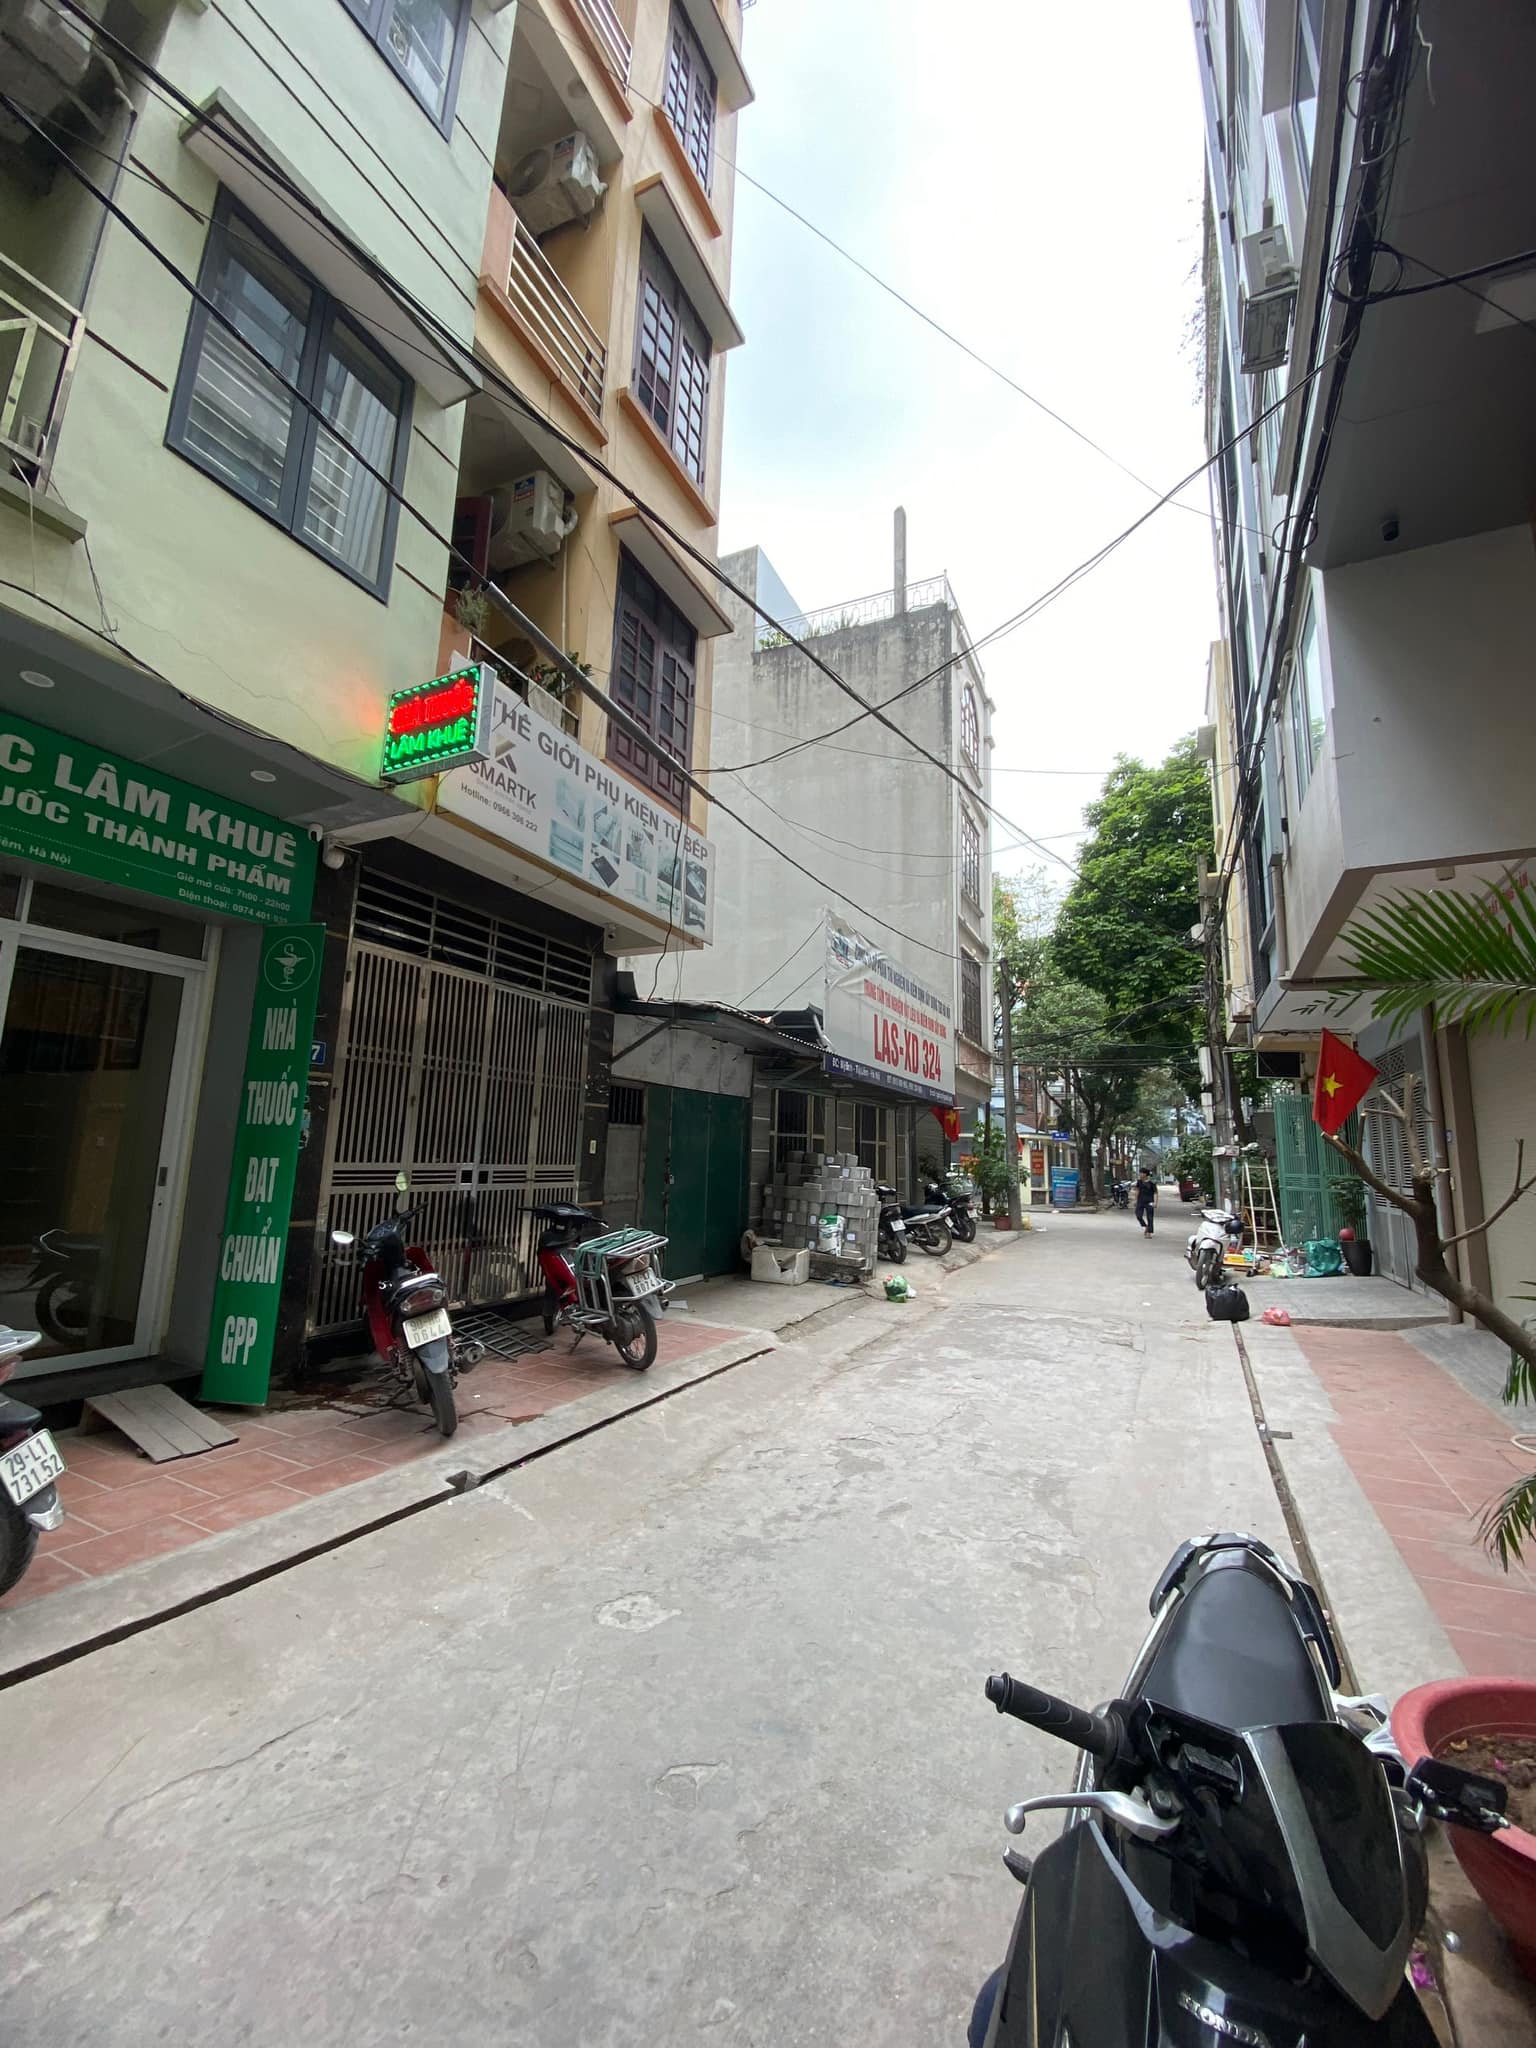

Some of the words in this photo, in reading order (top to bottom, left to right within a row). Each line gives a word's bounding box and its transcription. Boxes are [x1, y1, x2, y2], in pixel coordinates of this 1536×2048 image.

[460, 782, 492, 807] Hotline:
[469, 760, 537, 810] SMARTK
[537, 731, 580, 776] GIỚI
[585, 764, 620, 806] PHỤ
[624, 792, 659, 831] KIỆN
[54, 753, 172, 824] LÂM
[186, 802, 297, 868] KHUÊ
[29, 844, 47, 858] Hà
[50, 851, 72, 865] Nội
[84, 812, 197, 866] THÀNH
[207, 853, 291, 895] PHẨM
[176, 871, 195, 883] Giờ
[196, 878, 212, 889] mở
[237, 888, 258, 902] 7h00
[264, 897, 291, 912] 22h00
[178, 888, 201, 902] Điện
[262, 998, 297, 1050] NHÀ
[873, 1013, 919, 1074] LAS-XD
[922, 1039, 942, 1082] 324
[245, 1065, 299, 1126] THUỐC
[244, 1157, 279, 1214] ĐẠT
[221, 1217, 281, 1284] CHUẨN
[221, 1315, 258, 1366] GPP
[5, 1438, 48, 1477] 29-L1
[11, 1454, 62, 1500] 731.52
